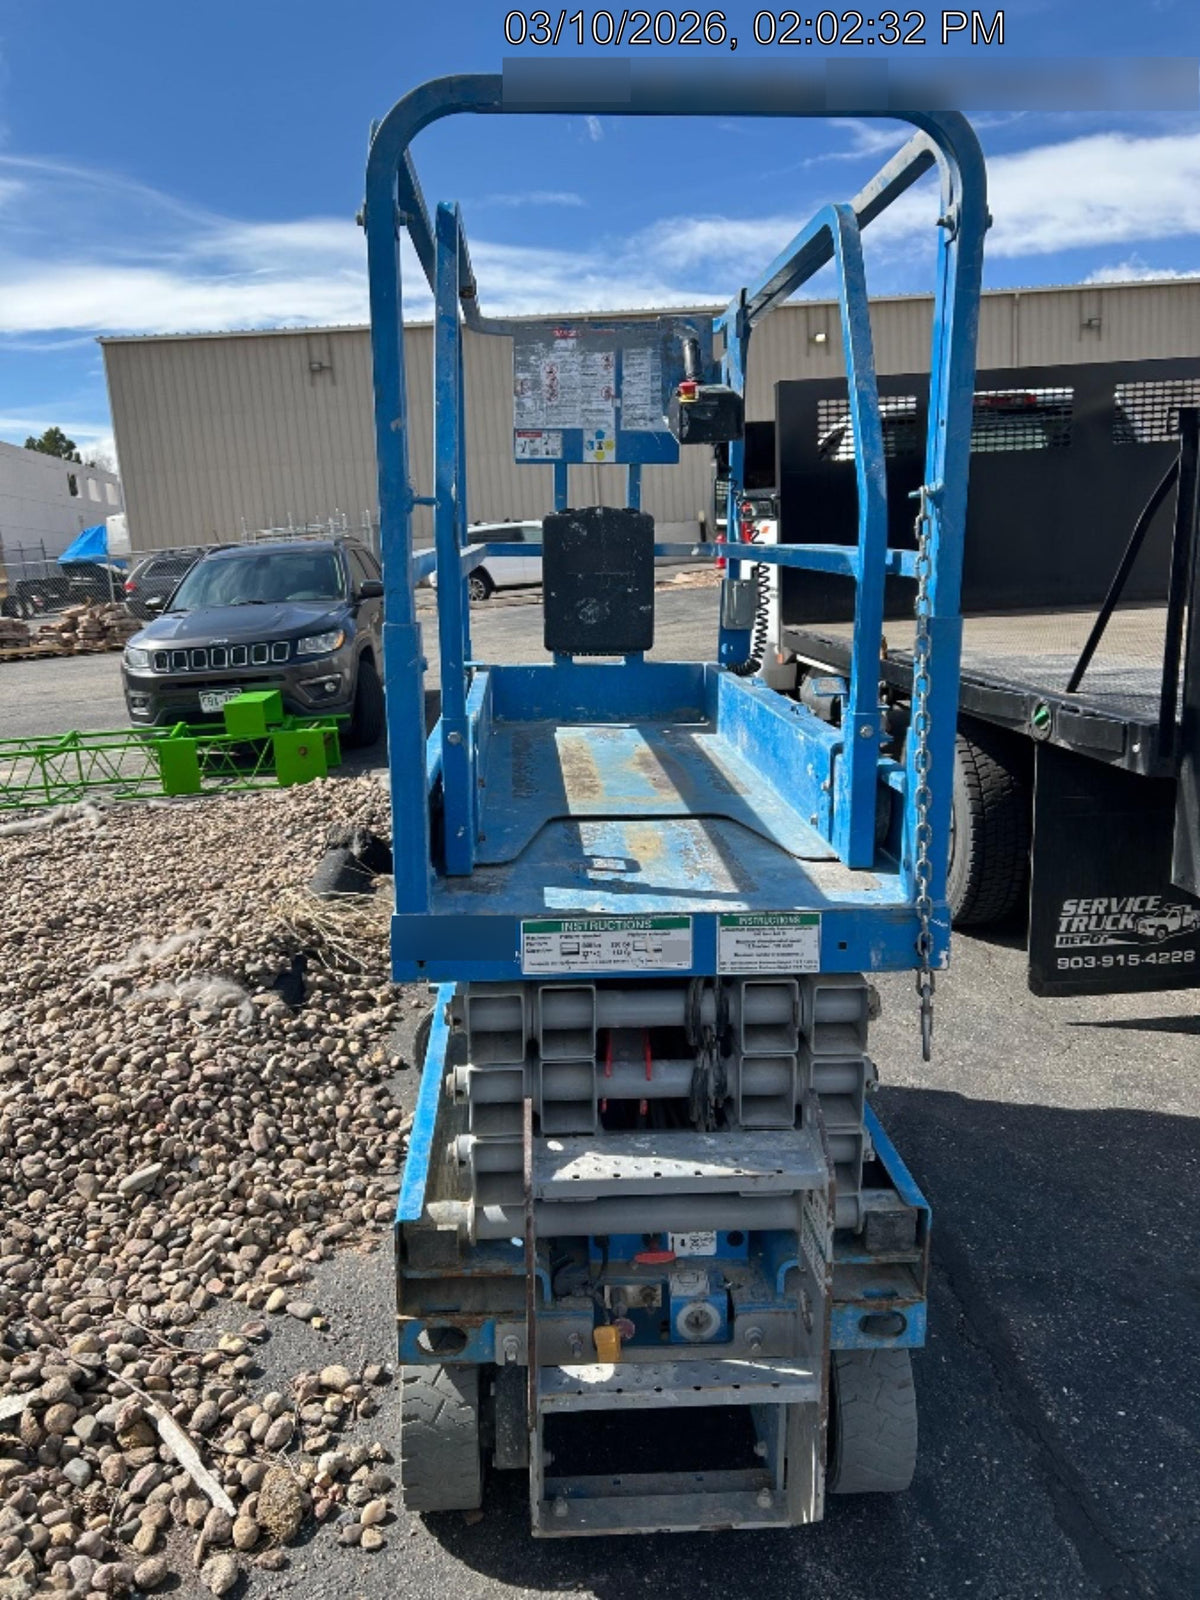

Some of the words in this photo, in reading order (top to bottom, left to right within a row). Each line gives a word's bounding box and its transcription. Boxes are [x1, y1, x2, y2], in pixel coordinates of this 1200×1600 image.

[1060, 895, 1162, 916] SERVICE
[561, 919, 653, 932] INSTRUCTIONS
[1059, 913, 1136, 932] TRUCK
